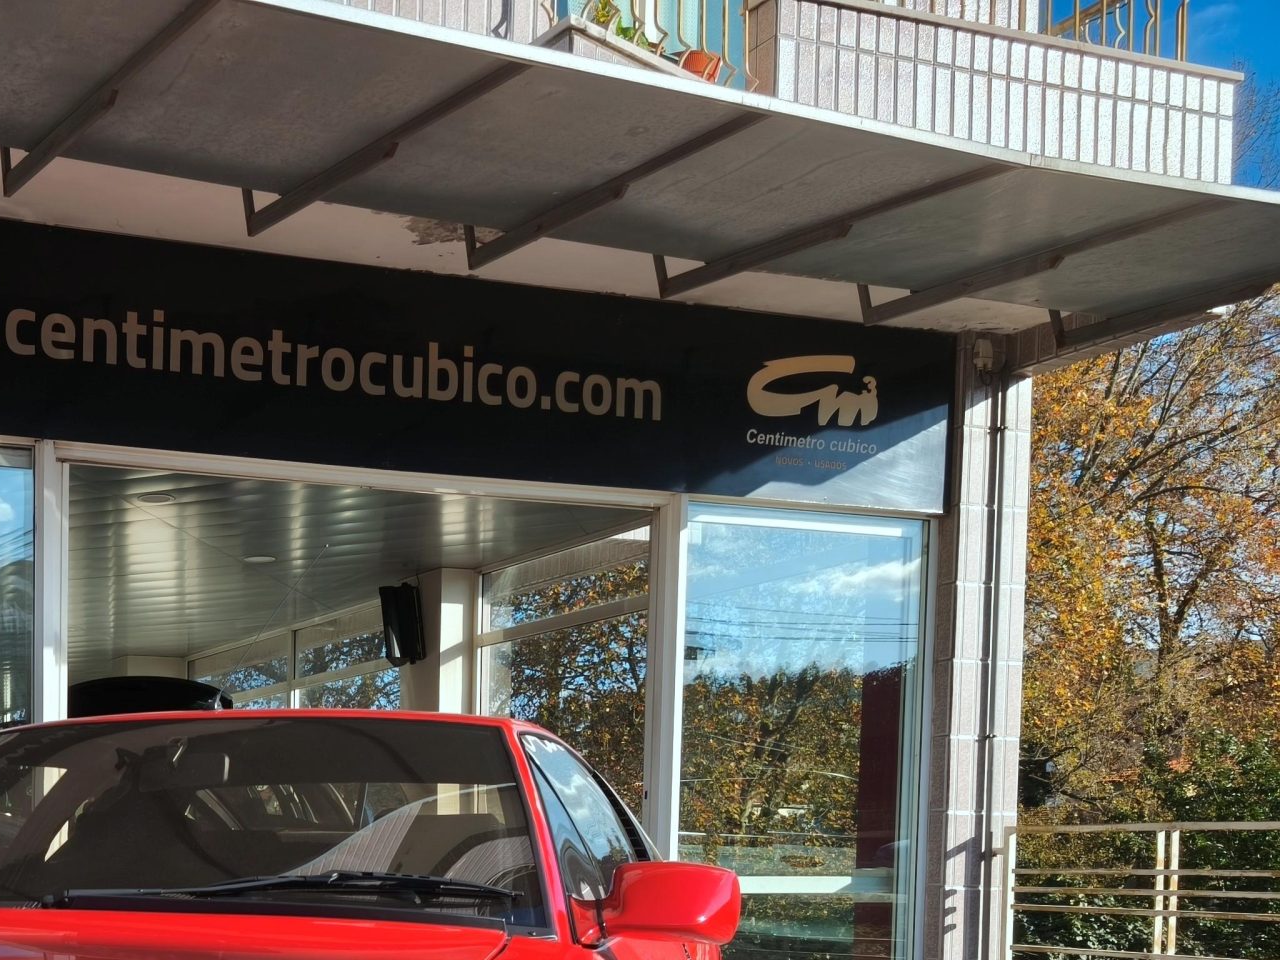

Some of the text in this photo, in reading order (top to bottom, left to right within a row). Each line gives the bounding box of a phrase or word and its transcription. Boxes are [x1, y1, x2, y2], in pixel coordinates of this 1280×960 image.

[746, 428, 877, 455] Centimetro cubico
[775, 455, 847, 470] NOVOS USADOS
